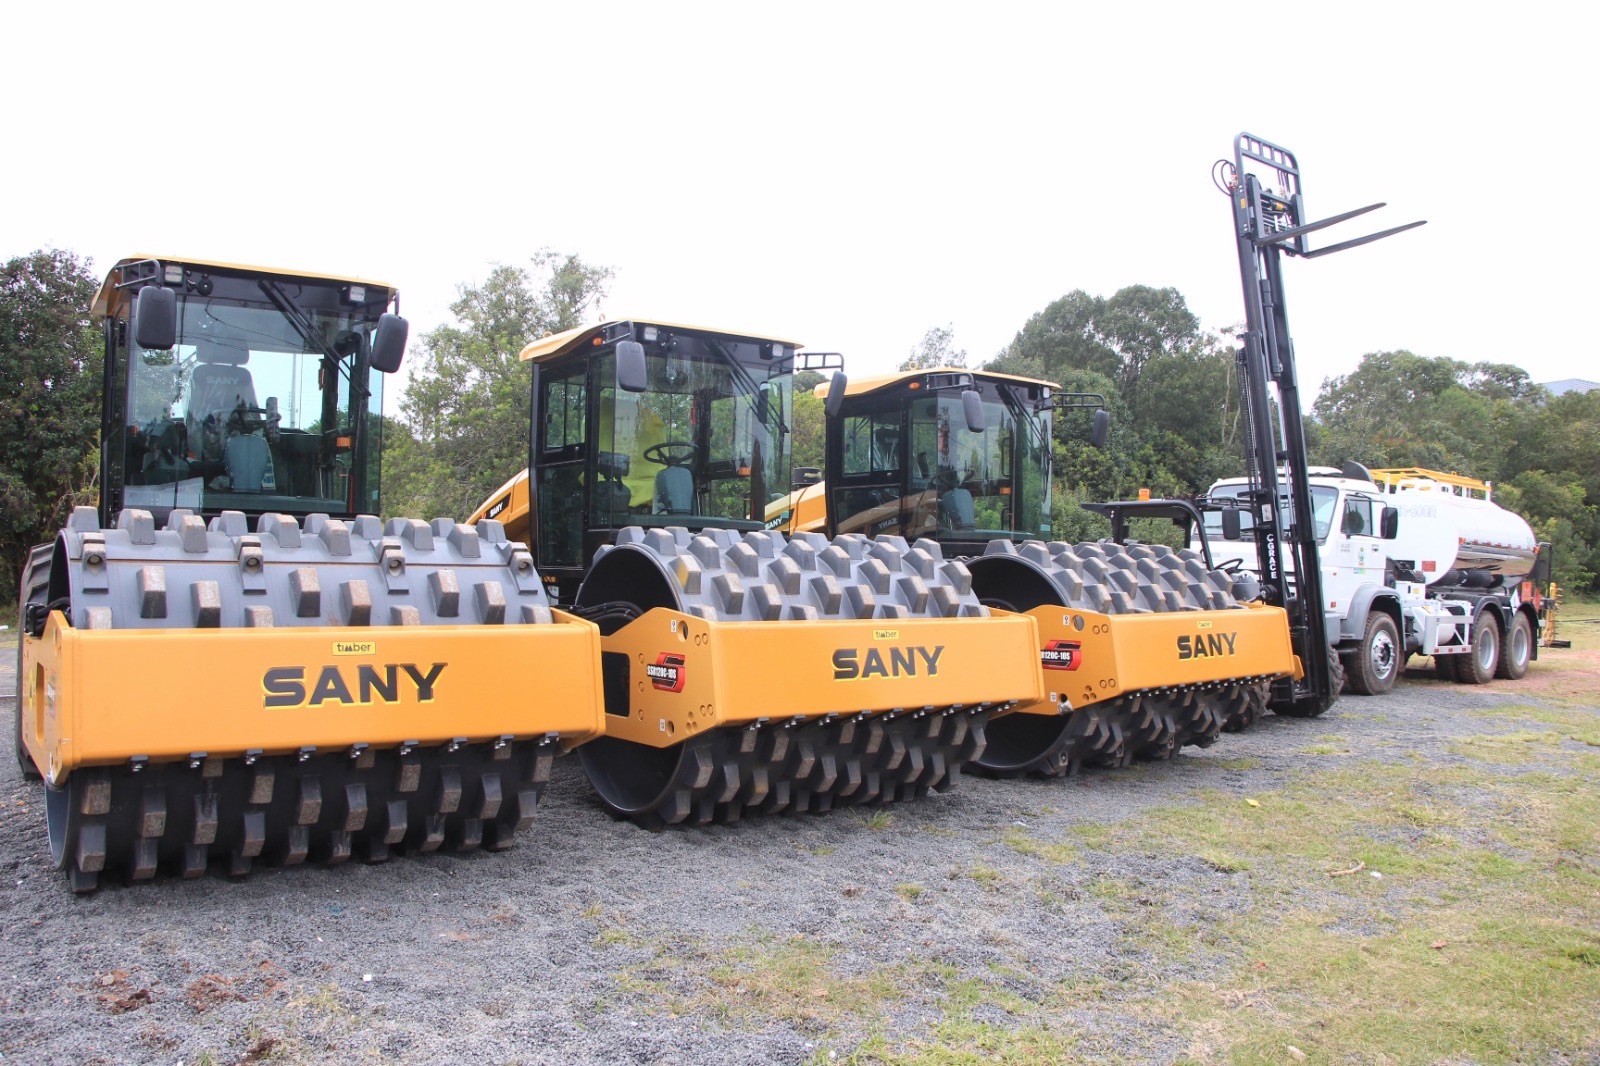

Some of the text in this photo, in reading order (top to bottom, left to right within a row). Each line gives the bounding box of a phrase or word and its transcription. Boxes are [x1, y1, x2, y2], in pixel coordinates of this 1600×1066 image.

[206, 376, 239, 385] SANY
[1266, 533, 1277, 579] CGRACE
[831, 645, 945, 681] SANY
[1176, 632, 1237, 660] SANY
[262, 662, 448, 708] SANY
